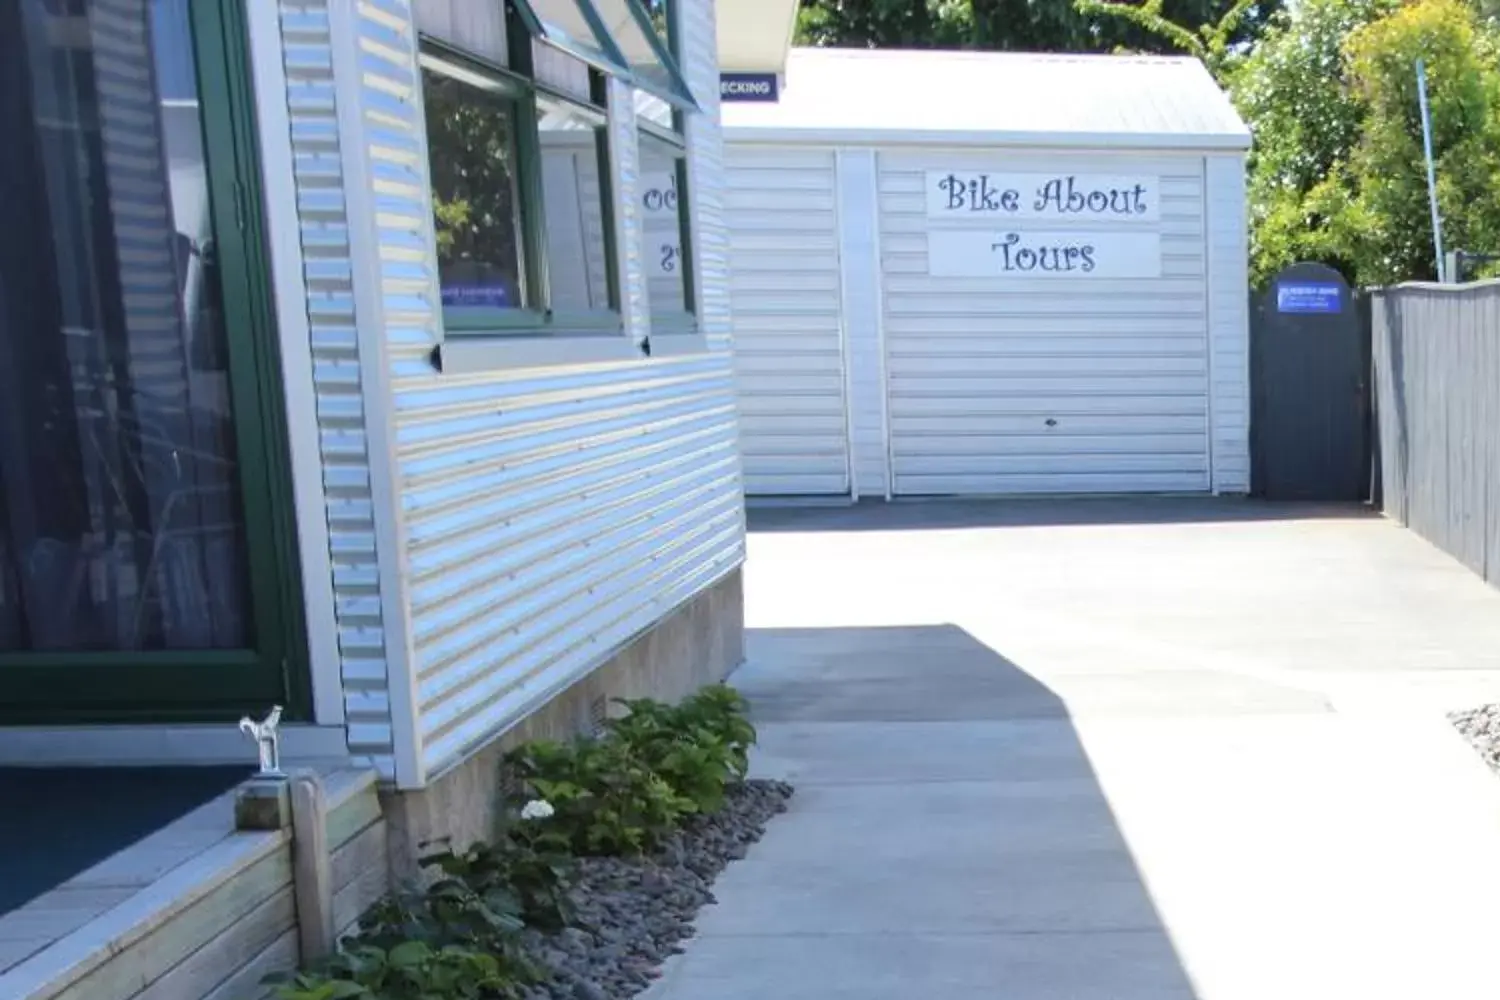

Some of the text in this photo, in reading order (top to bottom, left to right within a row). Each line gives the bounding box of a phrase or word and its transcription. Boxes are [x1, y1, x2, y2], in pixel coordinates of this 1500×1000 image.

[938, 174, 1147, 214] Bike About
[991, 233, 1096, 273] Tours
